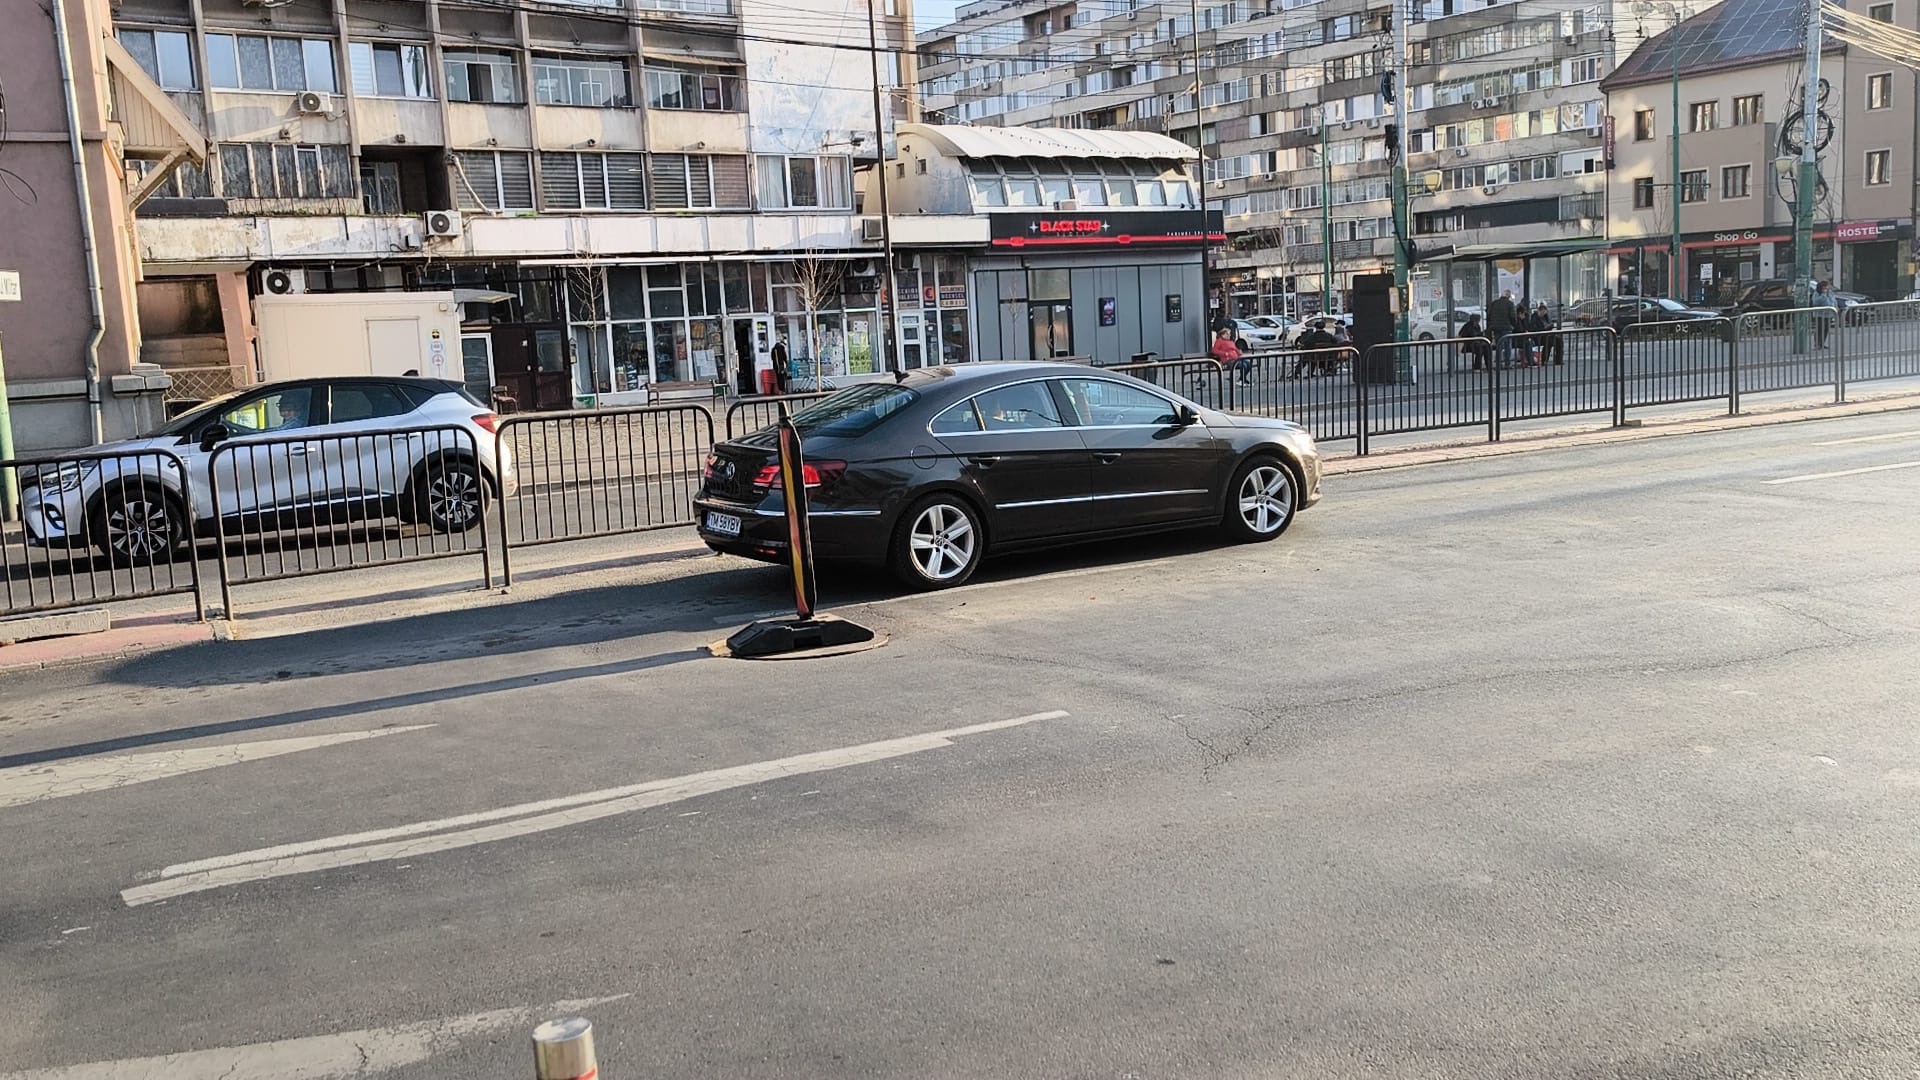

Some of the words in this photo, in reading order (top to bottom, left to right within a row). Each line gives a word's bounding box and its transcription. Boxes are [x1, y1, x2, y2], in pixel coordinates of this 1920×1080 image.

[1040, 221, 1074, 232] BLACK
[1076, 220, 1102, 232] STAR
[1838, 226, 1882, 237] HOSTEL
[1714, 232, 1740, 243] Shop
[1743, 230, 1758, 240] Go
